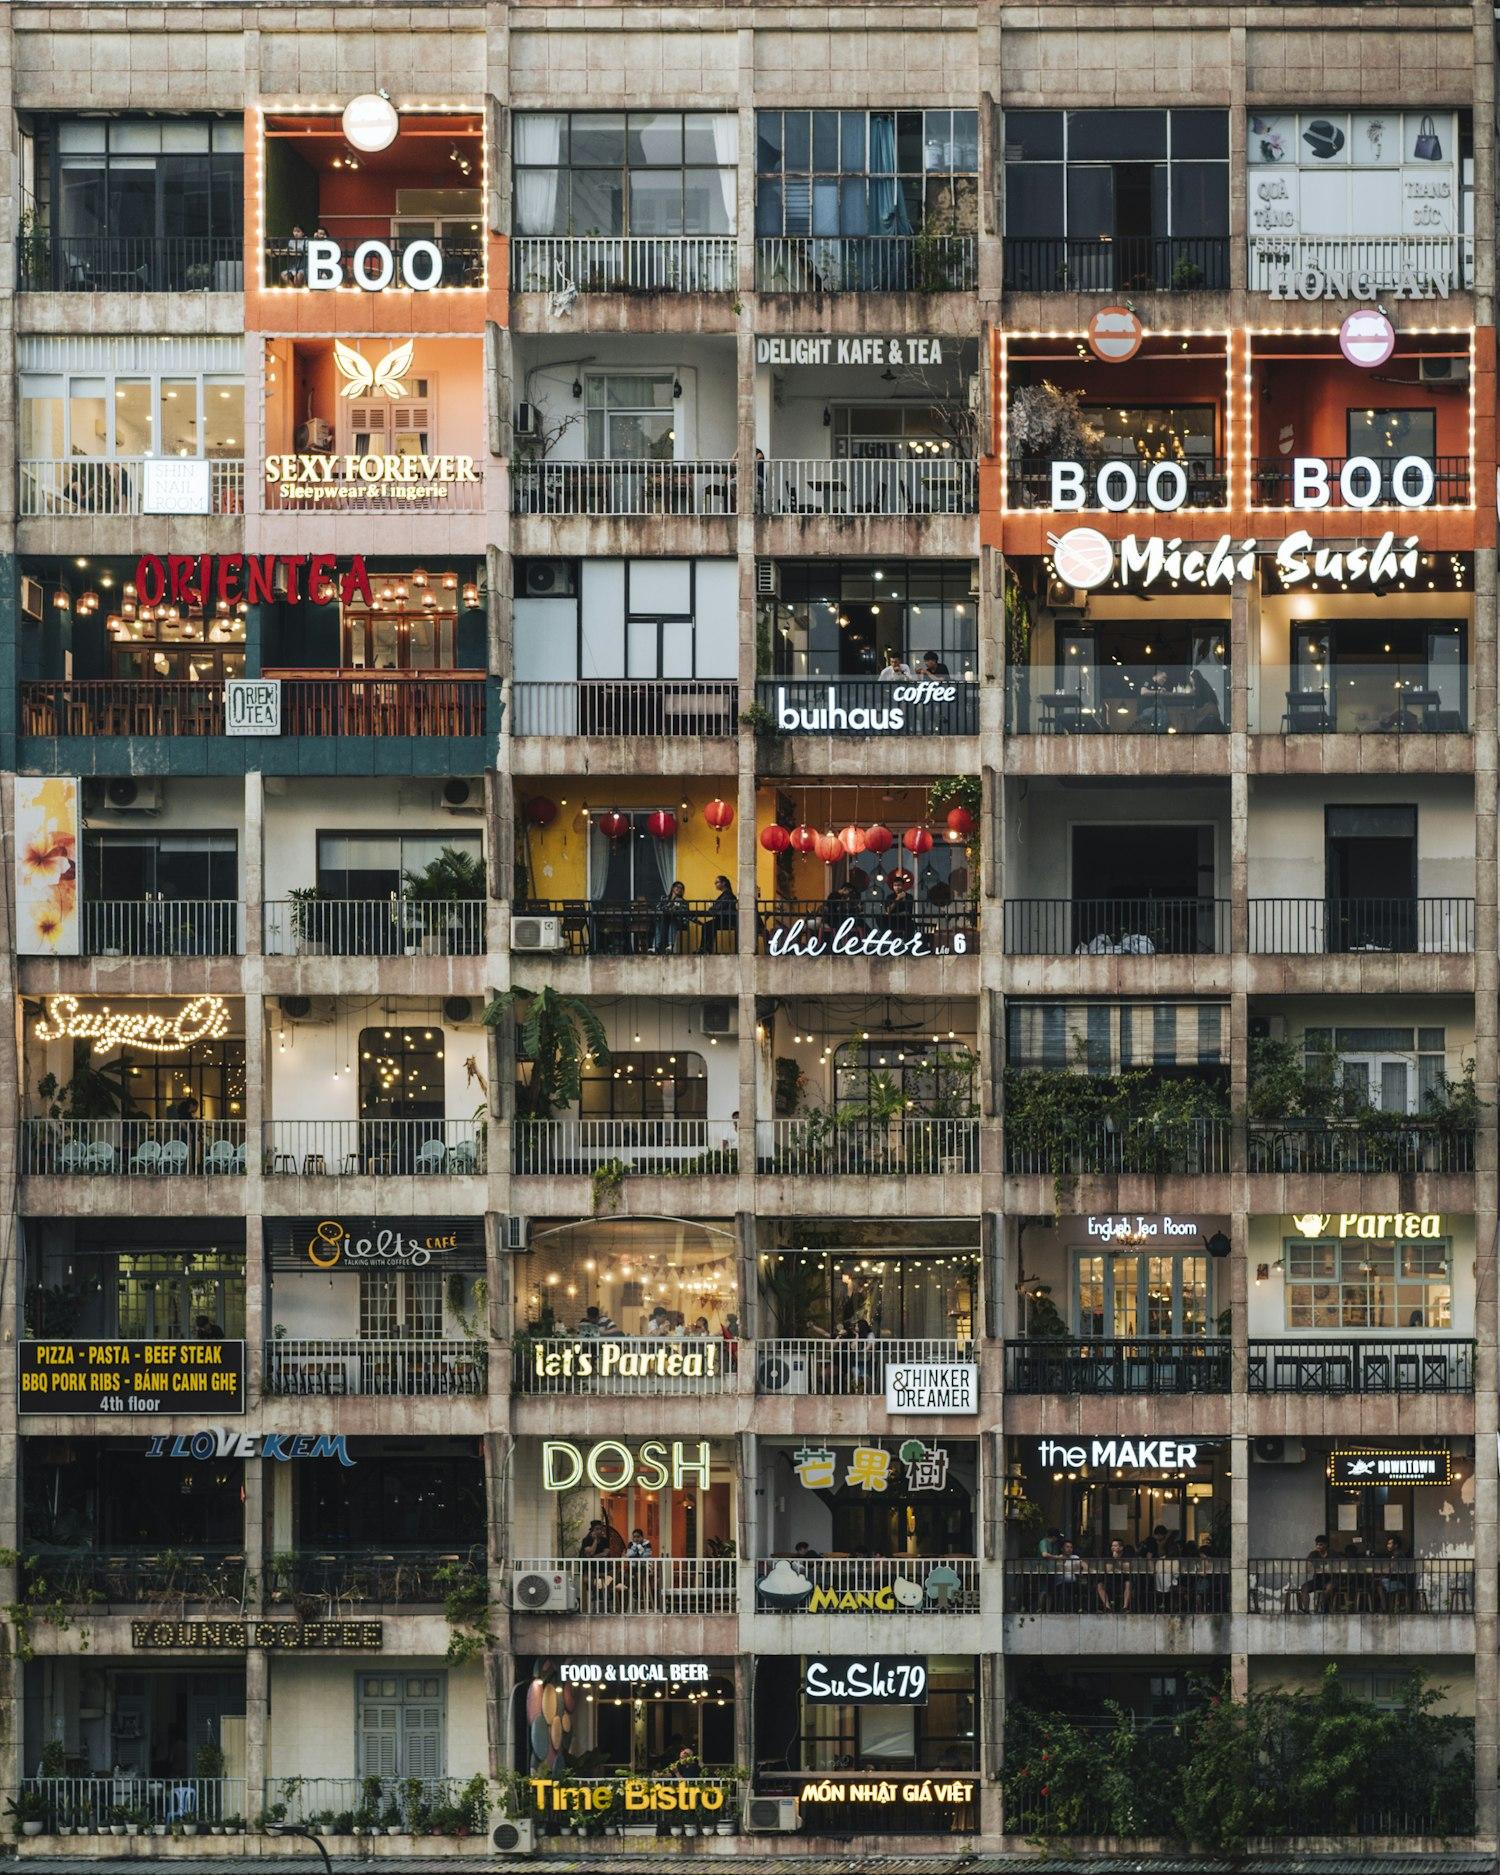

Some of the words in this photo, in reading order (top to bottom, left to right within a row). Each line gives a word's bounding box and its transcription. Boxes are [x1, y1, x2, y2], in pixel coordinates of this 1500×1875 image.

[307, 239, 444, 292] BOO
[757, 338, 832, 365] DELIGHT
[837, 338, 884, 365] KAFE
[889, 338, 903, 366] &
[906, 338, 943, 365] TEA
[265, 455, 339, 483] SEXY
[344, 455, 480, 483] FOREVER
[1293, 455, 1435, 509] BOO
[1050, 460, 1188, 512] BOO
[1122, 533, 1256, 587] Michi
[1276, 530, 1419, 583] Sushi
[135, 552, 374, 607] ORIENTEA
[893, 681, 956, 704] coffee
[768, 919, 827, 957] the
[832, 917, 931, 957] letter
[953, 932, 966, 954] 6
[35, 995, 174, 1054] Saigon
[1136, 1216, 1157, 1235] Tea
[1163, 1216, 1197, 1235] Room
[426, 1232, 458, 1249] CAFÉ
[344, 1258, 369, 1266] TALKING
[370, 1258, 386, 1266] WITH
[387, 1258, 410, 1266] COFFEE
[37, 1345, 75, 1365] PIZZA
[88, 1345, 130, 1365] PASTA
[144, 1345, 177, 1364] BEEF
[180, 1345, 222, 1364] STEAK
[534, 1344, 593, 1377] let's
[602, 1344, 716, 1377] Partea!
[22, 1372, 48, 1394] BBQ
[52, 1372, 87, 1392] PORK
[91, 1372, 120, 1392] RIBS
[134, 1368, 169, 1392] BÁNH
[172, 1372, 208, 1392] CANH
[211, 1372, 237, 1396] GHẸ
[100, 1396, 124, 1412] 4th
[128, 1396, 161, 1412] floor
[897, 1389, 970, 1407] DREAMER
[145, 1433, 169, 1458] I
[170, 1424, 262, 1461] LOVE
[261, 1433, 357, 1467] KEM
[1038, 1440, 1087, 1468] the
[1092, 1440, 1198, 1468] MAKER
[543, 1440, 711, 1492] DOSH
[1377, 1459, 1436, 1474] DOWNTOWN
[133, 1622, 246, 1647] YOUNG
[255, 1622, 381, 1647] COFFEE
[561, 1664, 601, 1682] FOOD
[604, 1664, 617, 1682] &
[620, 1663, 668, 1682] LOCAL
[670, 1663, 710, 1681] BEER
[530, 1779, 612, 1811] Time
[625, 1778, 725, 1811] Bistro
[801, 1779, 845, 1802] MÓN
[850, 1781, 898, 1804] NHẬT
[902, 1779, 933, 1802] GIÁ
[934, 1780, 974, 1804] VIỆT
